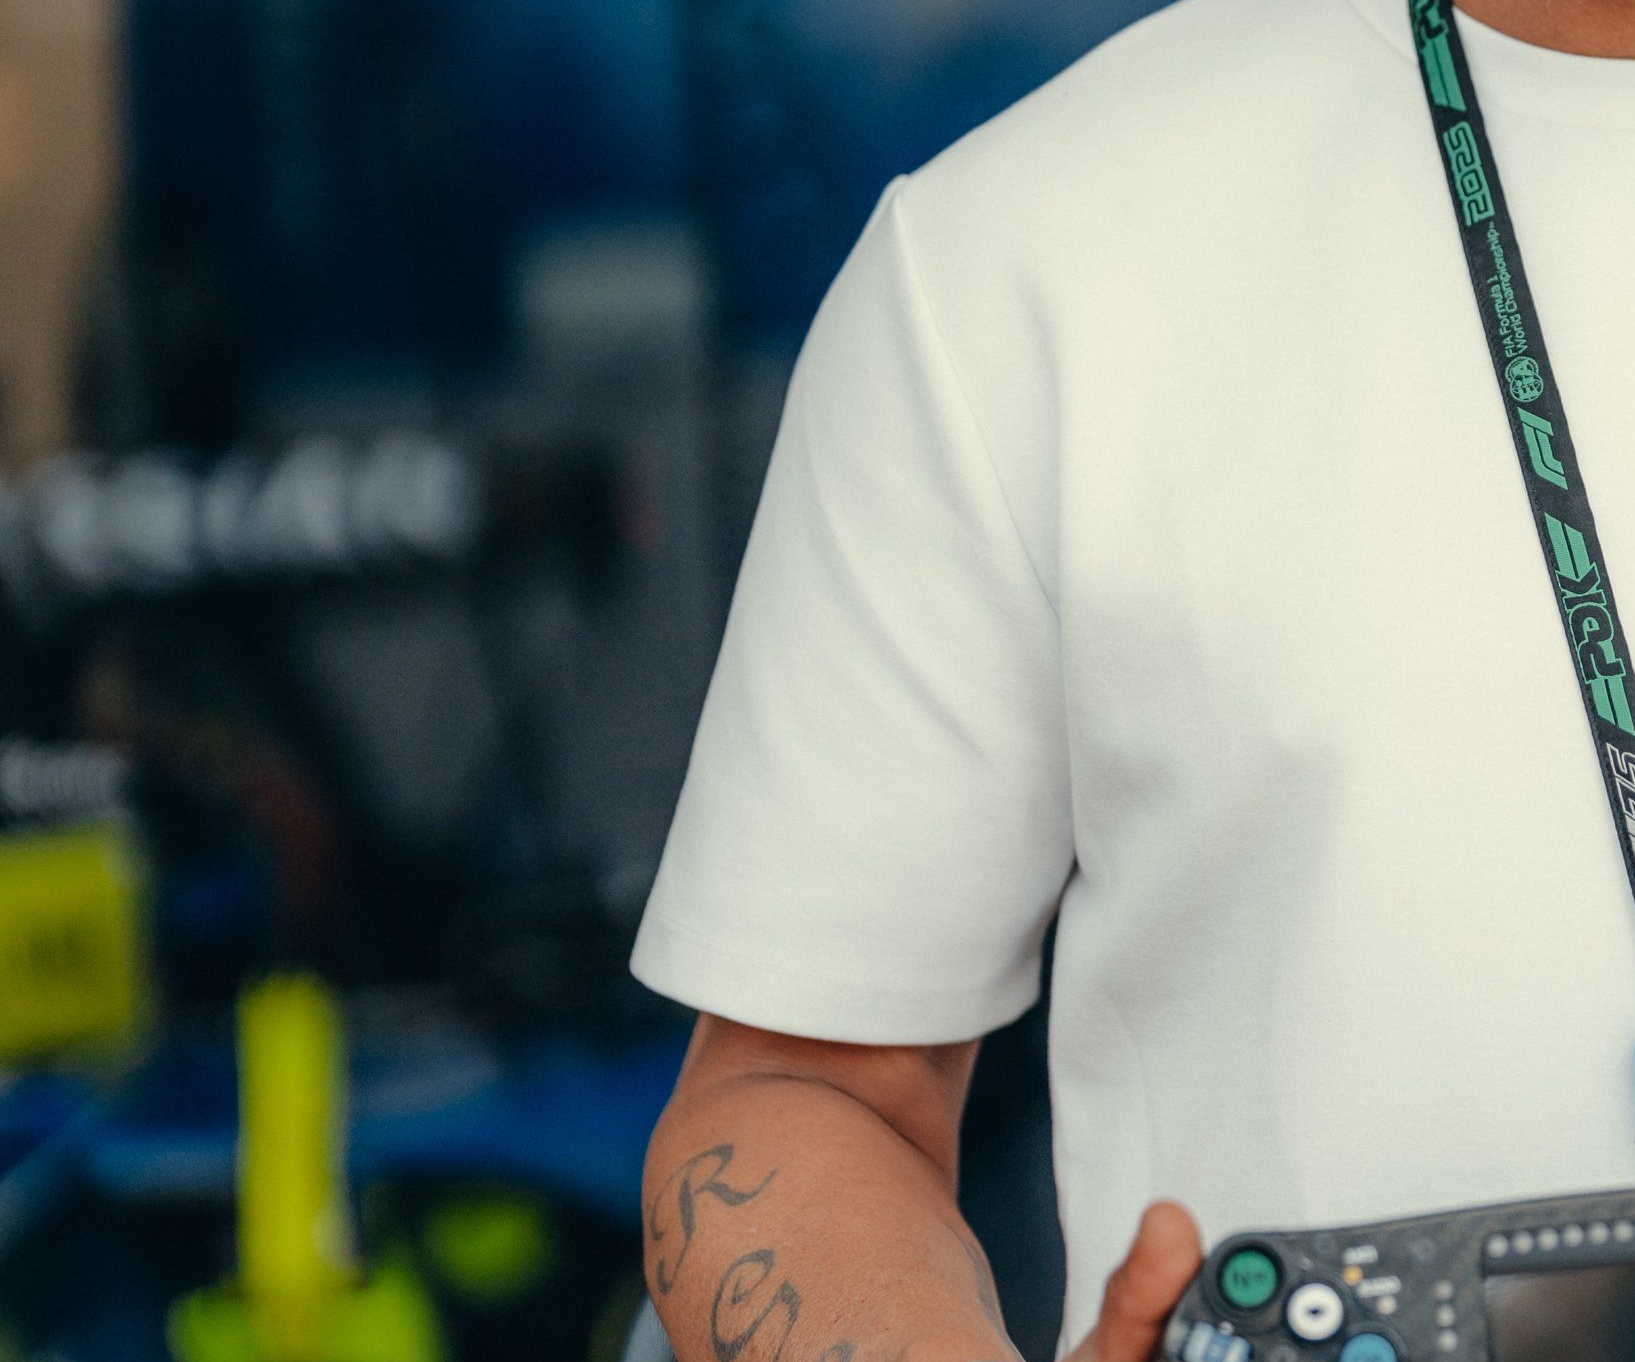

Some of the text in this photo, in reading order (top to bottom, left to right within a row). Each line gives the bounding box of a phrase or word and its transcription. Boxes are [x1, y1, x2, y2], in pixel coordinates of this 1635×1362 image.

[1442, 121, 1496, 226] 2025
[1492, 284, 1510, 335] Formula
[1511, 314, 1529, 355] World
